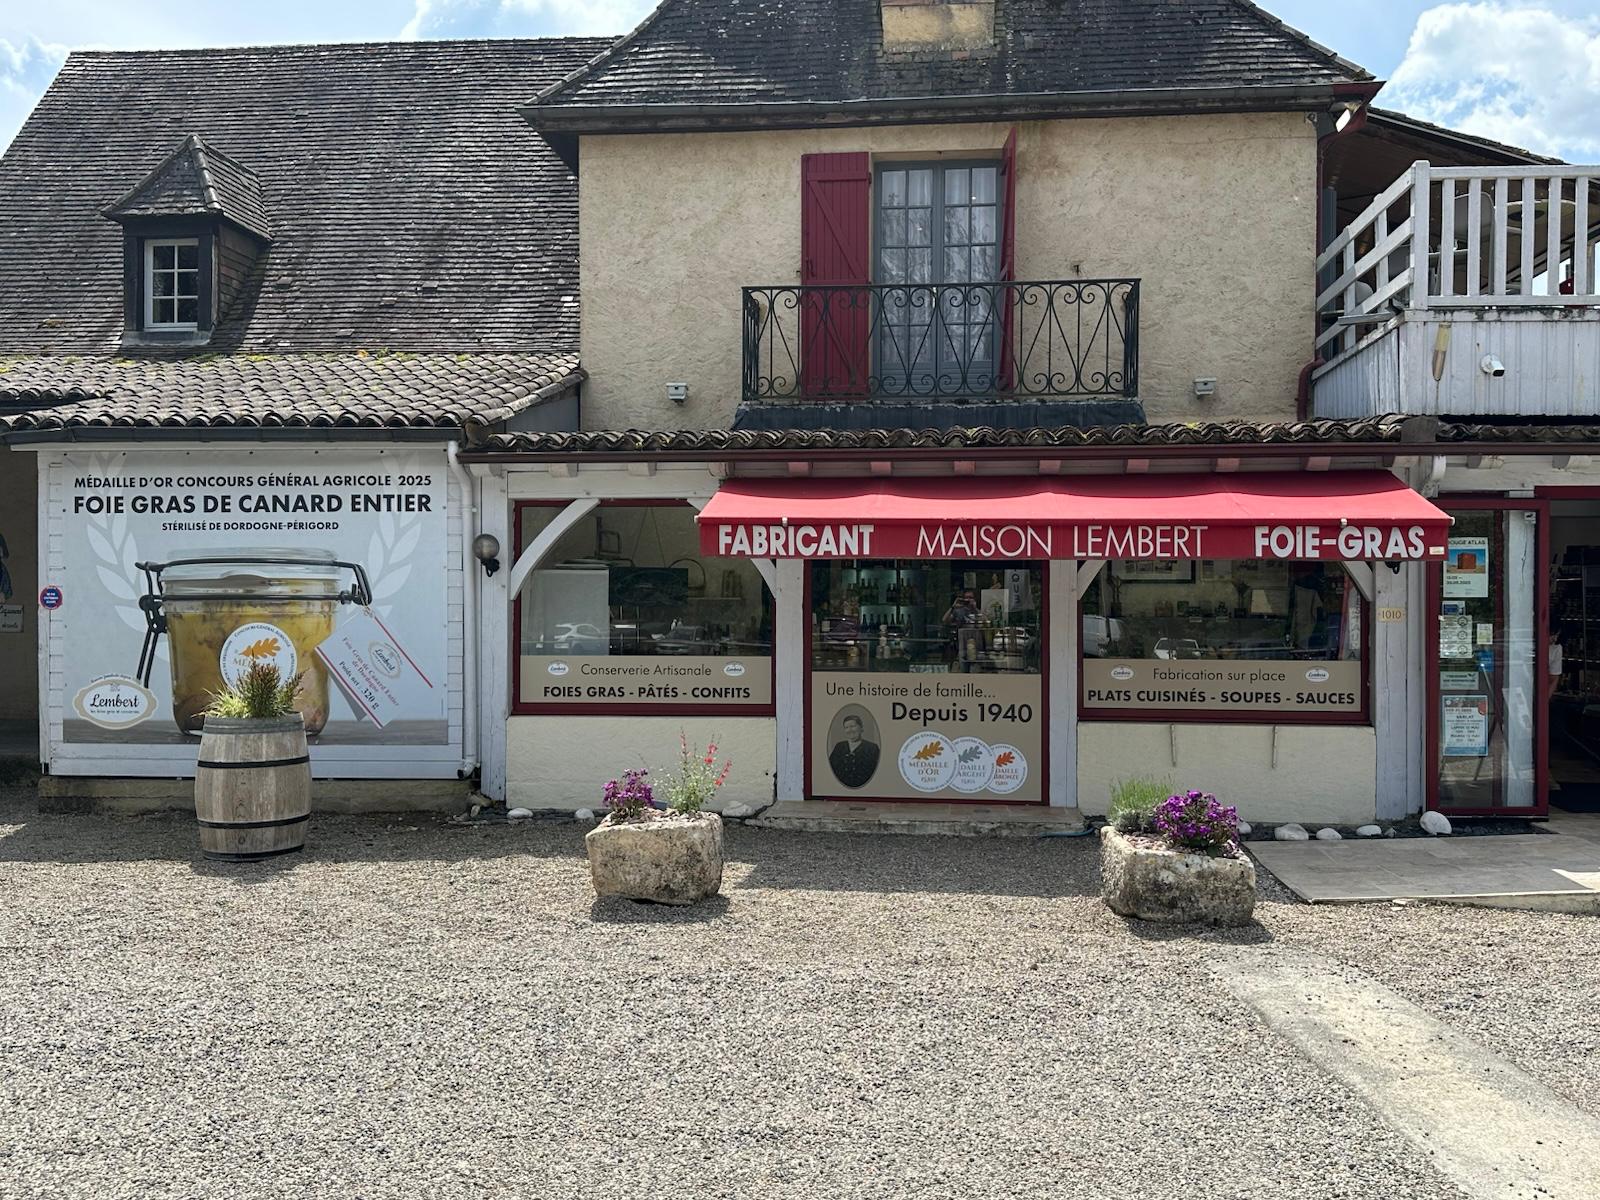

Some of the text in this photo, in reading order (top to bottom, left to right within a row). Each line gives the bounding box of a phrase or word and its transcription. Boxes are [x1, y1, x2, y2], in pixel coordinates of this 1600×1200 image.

[74, 475, 135, 488] MÉDAILLE
[177, 476, 254, 487] CONCOURS
[257, 473, 319, 486] GÉNÉRAL
[323, 475, 391, 486] AGRICOLE
[398, 475, 431, 486] 2025
[74, 494, 432, 514] FOIE GRAS DE CANARD ENTIER
[162, 520, 339, 531] STÉRILISÉ DE DORDOGNE-PÉRIGORD
[718, 525, 1424, 558] FABRICANT MAISON LEMBERT FOIE-GRAS
[1382, 611, 1402, 619] 1010
[581, 664, 712, 676] Conserverie Artisanale
[1153, 668, 1286, 684] Fabrication sur place
[361, 688, 376, 703] 320
[543, 686, 582, 697] FOIES
[586, 686, 625, 697] GRAS
[638, 684, 678, 698] PÂTÉS
[691, 687, 751, 698] CONFITS
[826, 682, 996, 698] Une histoire de famille...
[1088, 690, 1132, 702] PLATS
[1136, 688, 1206, 702] CUISINÉS
[1220, 691, 1281, 704] SOUPES
[1295, 692, 1355, 704] SAUCES
[90, 693, 140, 708] Lembert
[892, 702, 1033, 727] Depuis 1940
